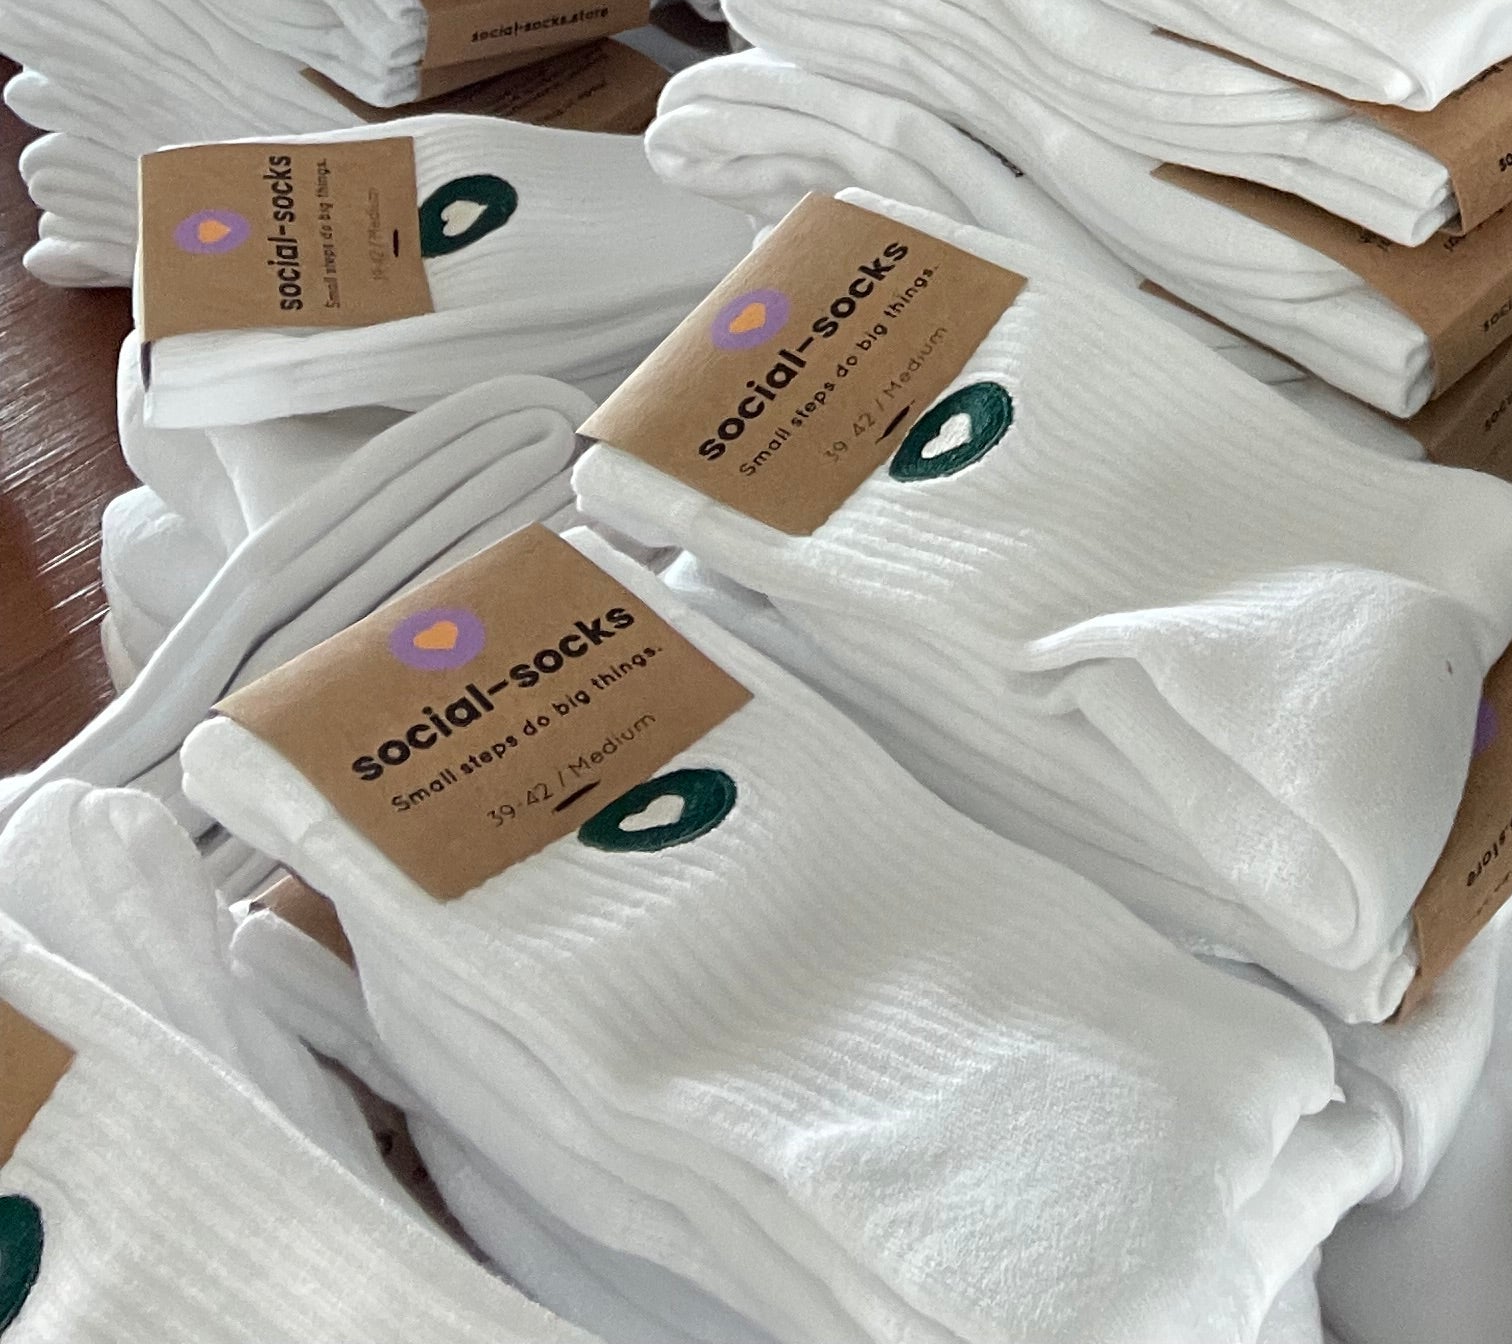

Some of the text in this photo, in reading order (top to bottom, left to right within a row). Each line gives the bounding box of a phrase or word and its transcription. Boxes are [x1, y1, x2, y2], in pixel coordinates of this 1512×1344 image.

[471, 5, 609, 43] social-socks.store
[263, 155, 304, 311] social-socks
[699, 242, 909, 461] social-socks
[739, 264, 940, 477] Small steps do big things.
[882, 326, 948, 399] Medium
[351, 607, 635, 782] social-socks
[391, 645, 663, 812] Small steps do big things.
[487, 782, 554, 827] 39-42
[568, 713, 657, 778] Medium
